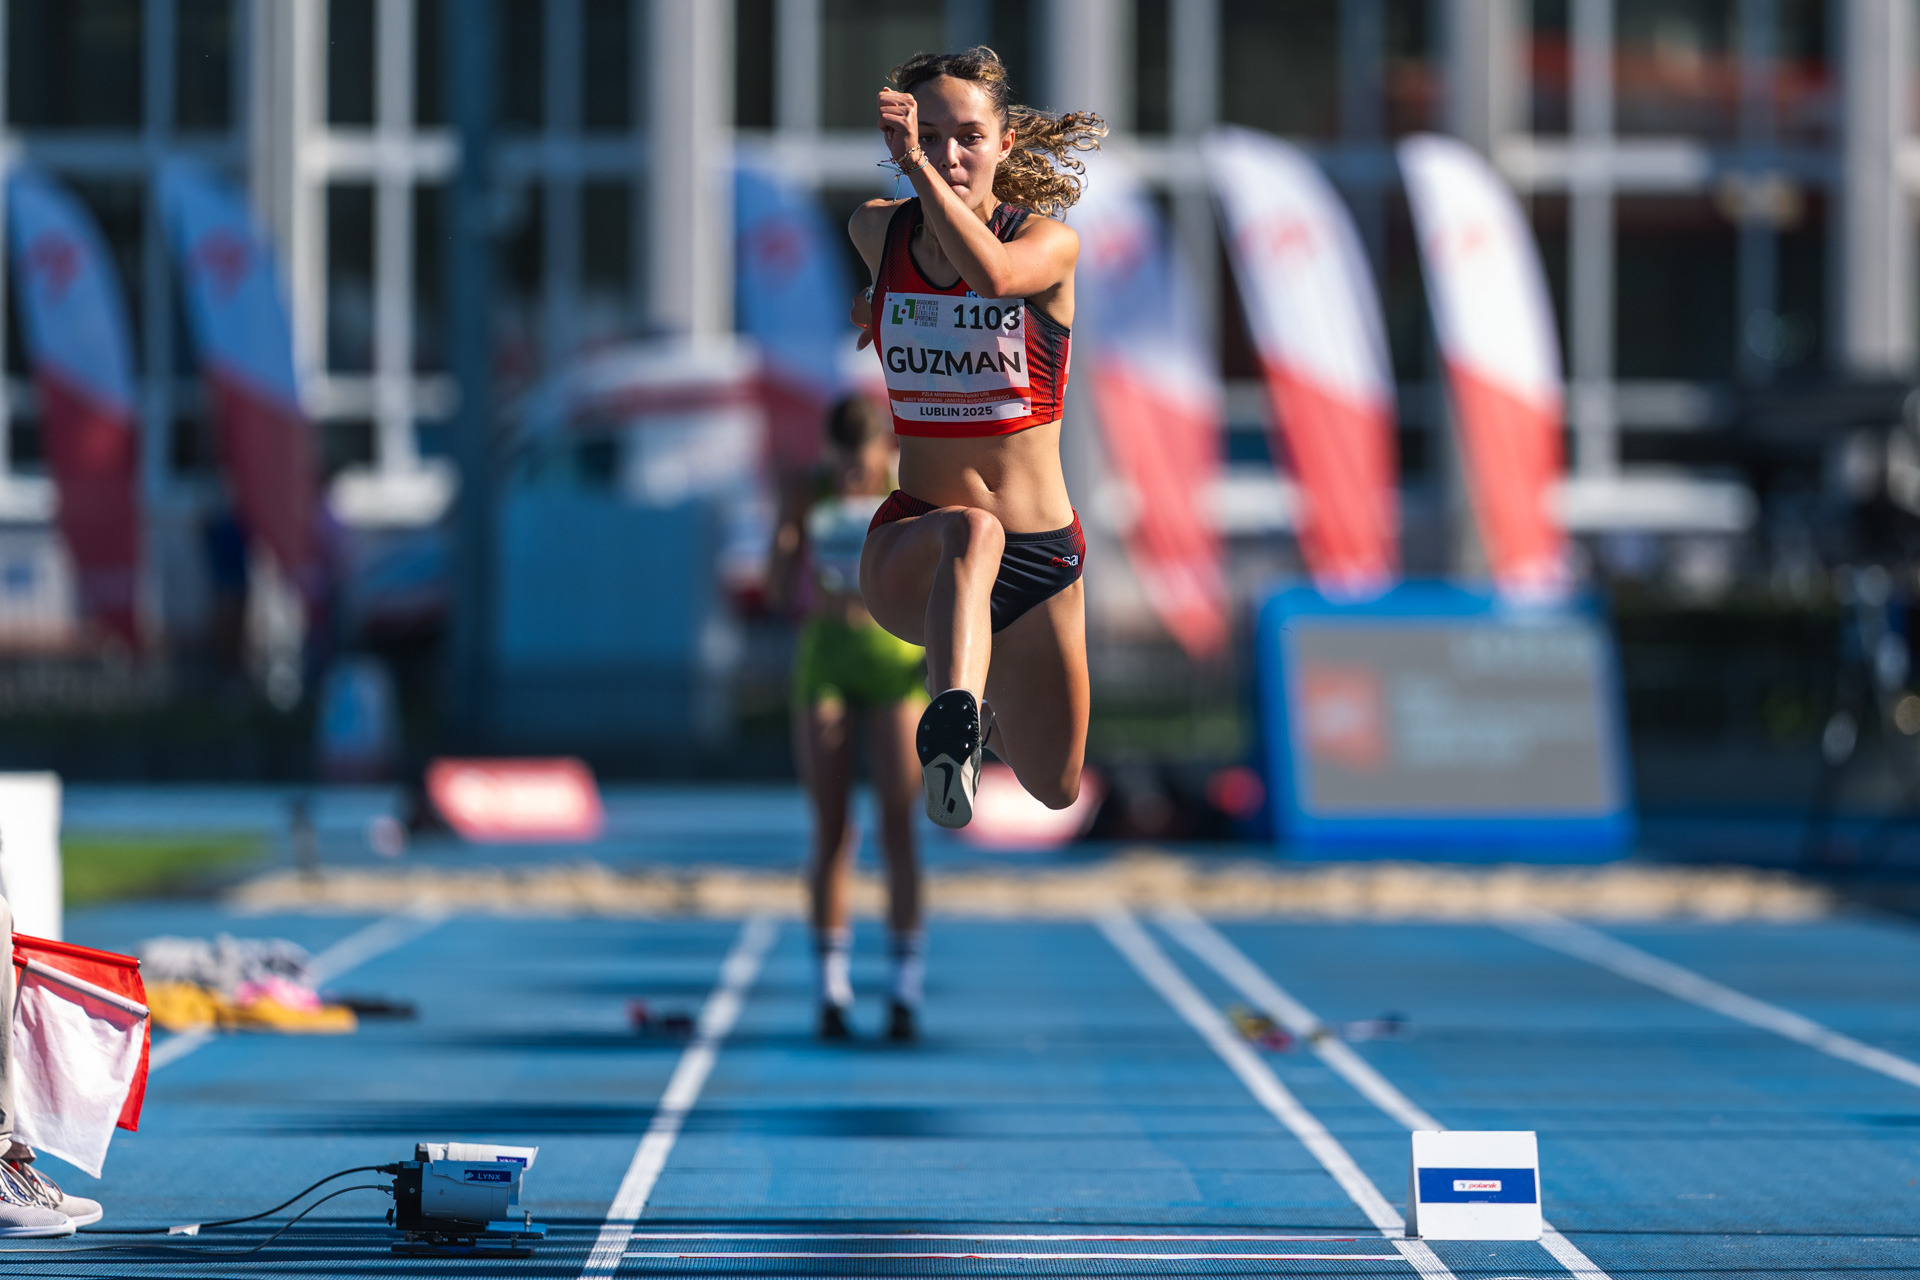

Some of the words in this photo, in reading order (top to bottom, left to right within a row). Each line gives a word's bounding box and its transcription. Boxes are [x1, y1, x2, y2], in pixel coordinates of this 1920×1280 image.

[953, 304, 1020, 330] 1103
[886, 346, 1022, 376] GUZMAN
[920, 406, 960, 417] LUBLIN
[962, 406, 993, 416] 2025
[477, 1172, 501, 1180] LYNX
